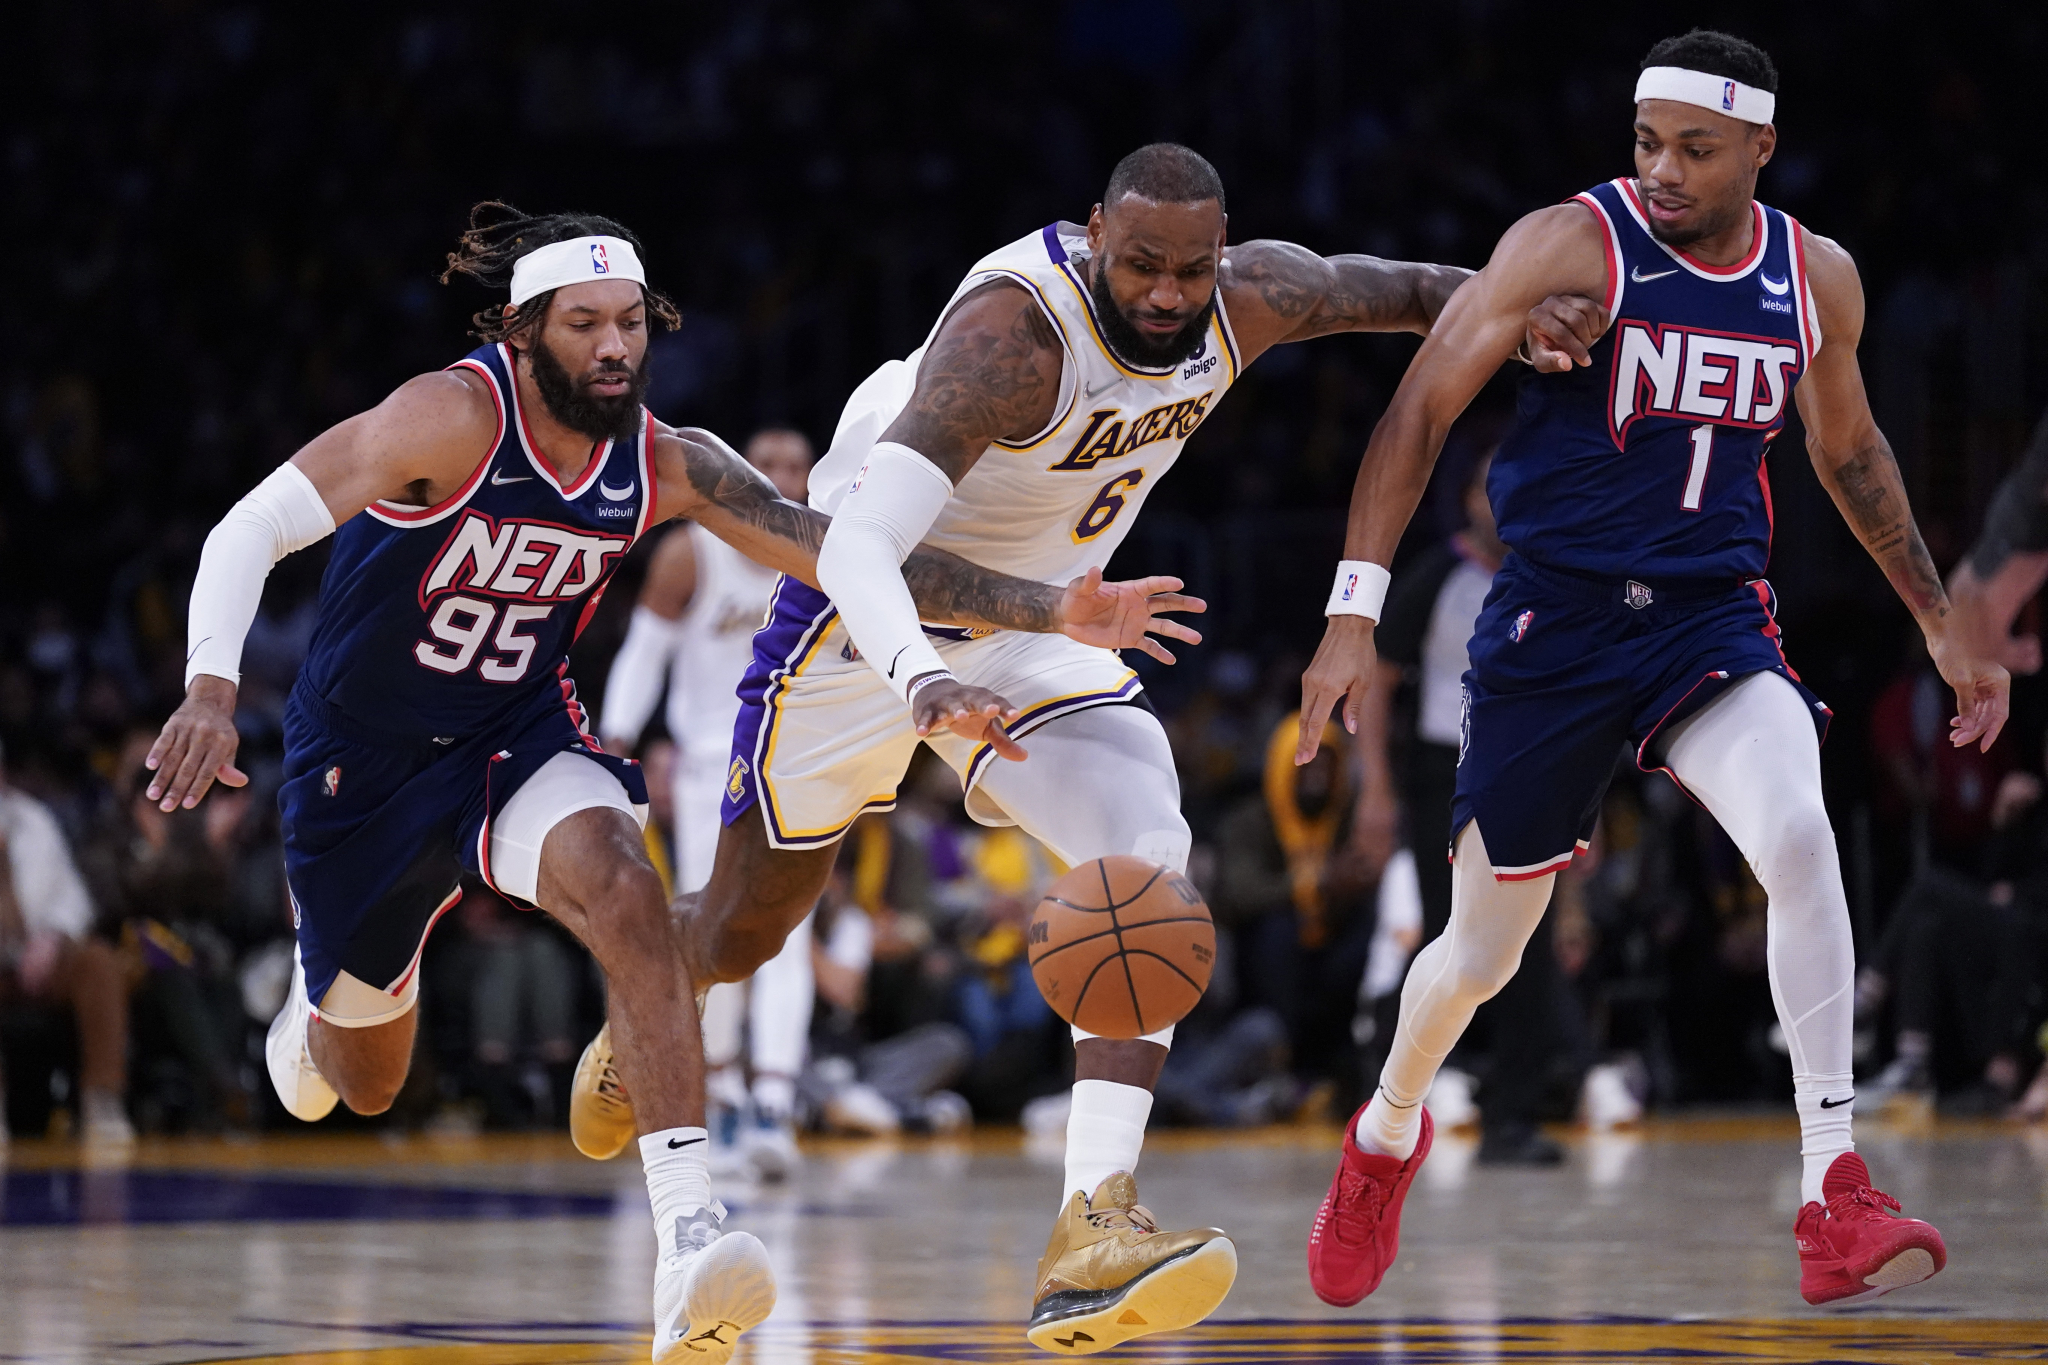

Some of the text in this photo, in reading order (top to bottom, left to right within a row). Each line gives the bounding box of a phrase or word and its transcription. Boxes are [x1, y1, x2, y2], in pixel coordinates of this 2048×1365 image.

[1762, 298, 1791, 314] Webull
[1184, 356, 1217, 380] bibigo
[1610, 321, 1799, 444] NETS
[1046, 389, 1214, 471] LAKERS
[1680, 424, 1714, 512] 1
[598, 507, 633, 517] Webull
[1070, 467, 1146, 545] 6
[422, 511, 631, 607] NETS
[1631, 584, 1650, 599] NETS
[412, 596, 556, 684] 95
